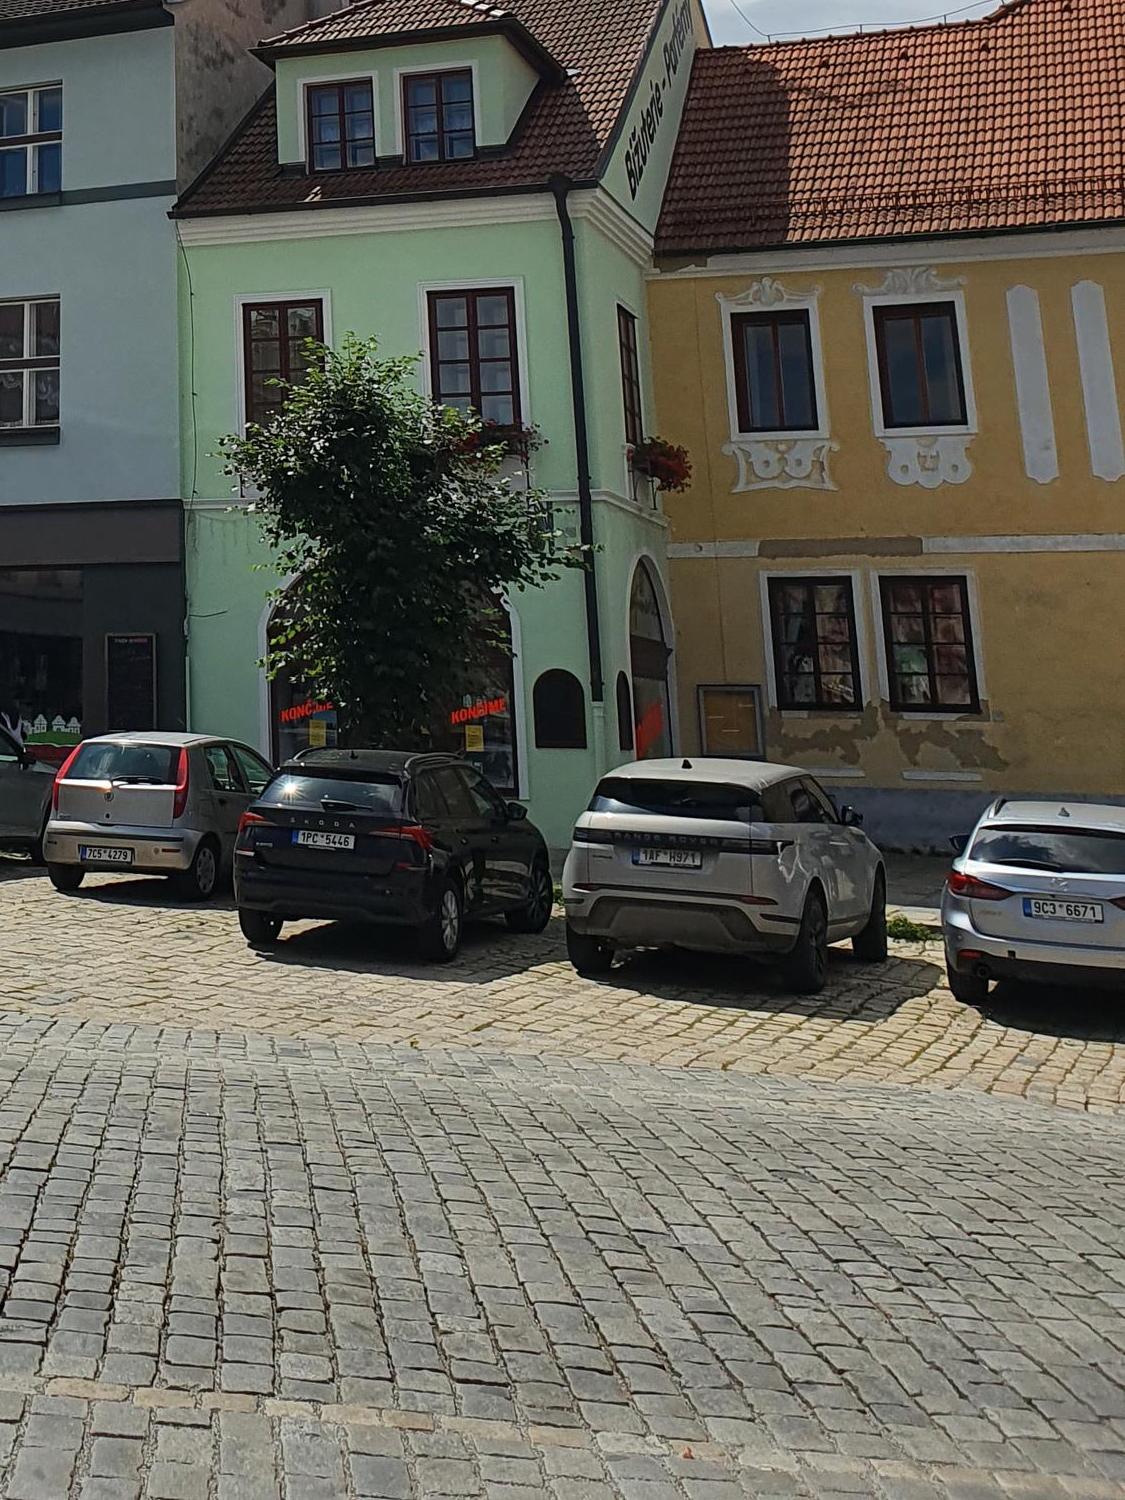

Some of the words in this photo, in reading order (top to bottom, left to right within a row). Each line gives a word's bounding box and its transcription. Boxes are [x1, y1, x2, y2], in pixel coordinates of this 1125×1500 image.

[625, 79, 664, 202] Bižuterie
[301, 831, 318, 844] 1PC
[325, 835, 350, 847] 5446
[87, 848, 102, 858] 7C5
[107, 850, 128, 861] 4279
[642, 849, 661, 861] 1AF
[669, 851, 695, 863] H971
[1033, 902, 1057, 915] 9C3
[1065, 904, 1096, 918] 6671
